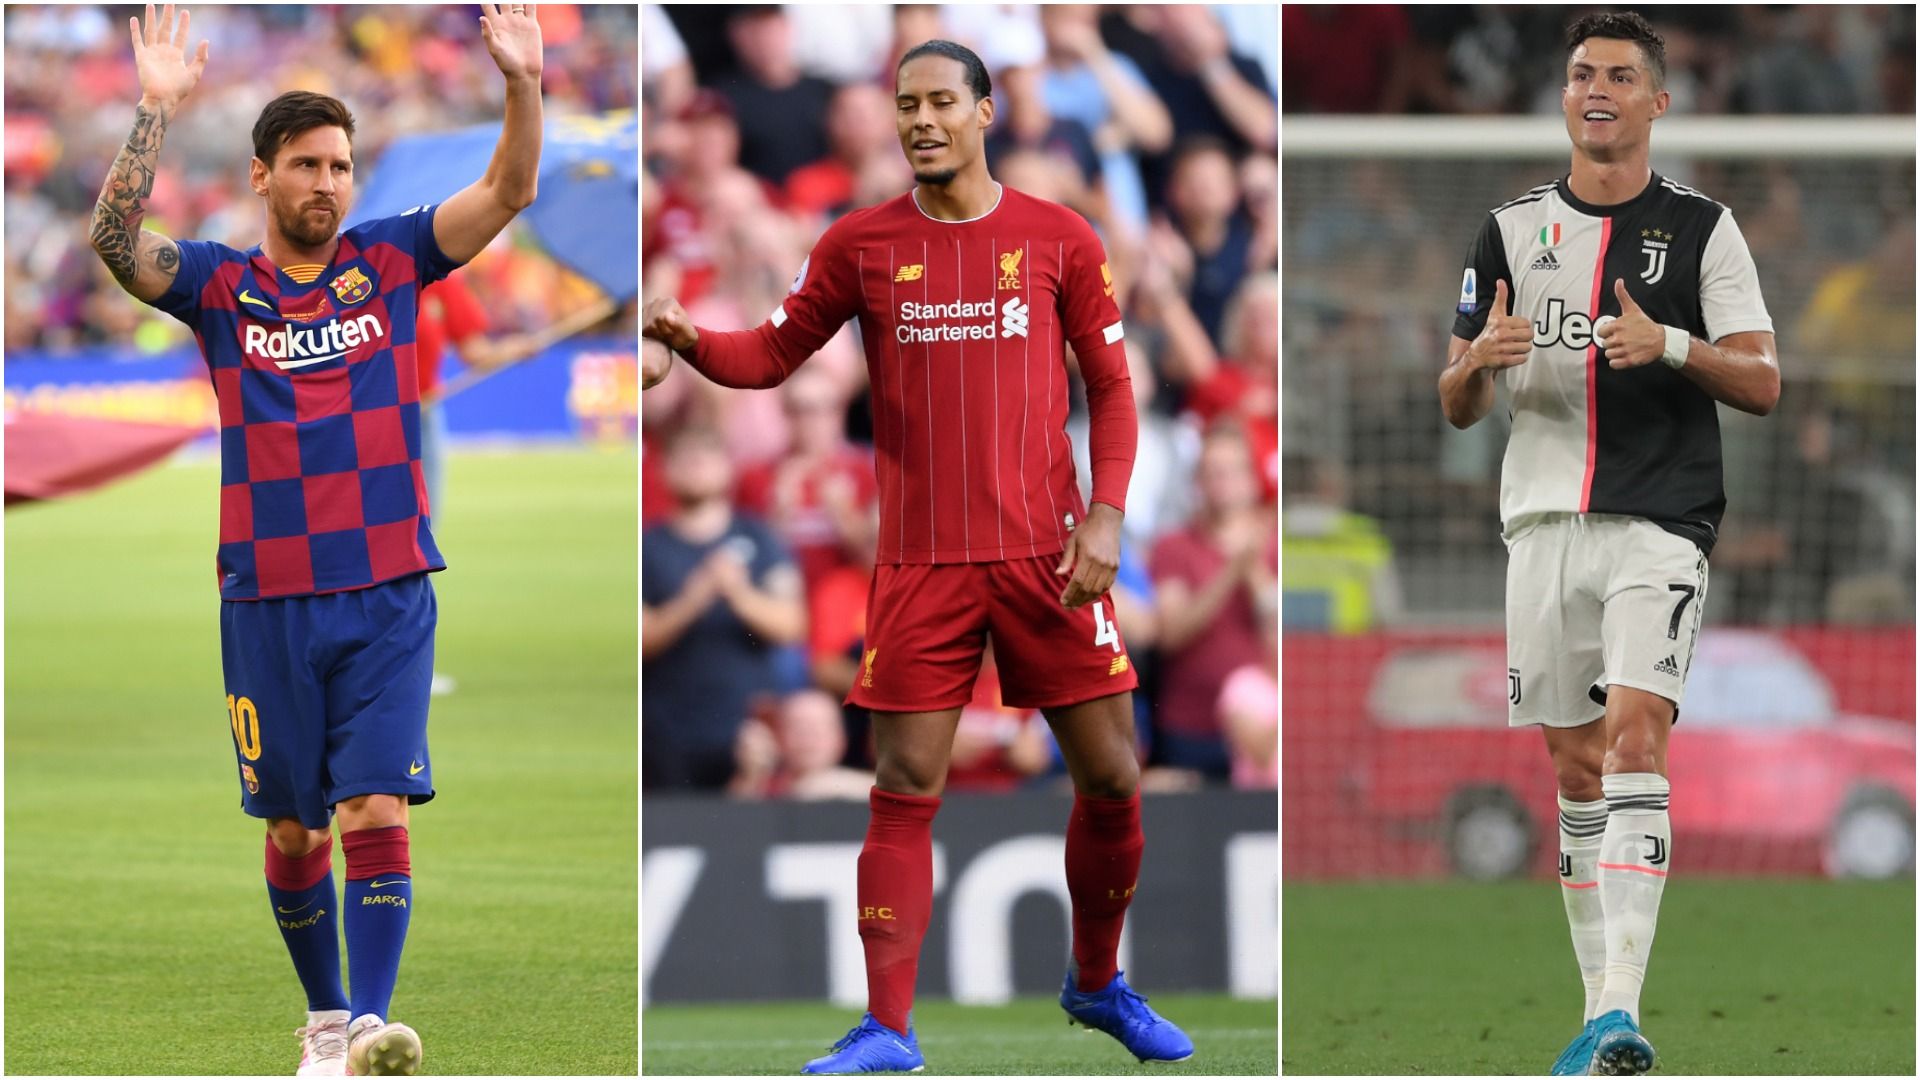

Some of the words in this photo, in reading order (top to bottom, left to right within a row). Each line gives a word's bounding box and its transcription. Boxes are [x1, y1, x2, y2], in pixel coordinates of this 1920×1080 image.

[900, 298, 996, 320] Standard
[245, 313, 384, 359] Rakuten
[896, 320, 996, 343] Chartered
[1092, 601, 1121, 653] 4
[1668, 583, 1695, 640] 7
[1654, 664, 1680, 677] adidas
[227, 694, 262, 761] 10
[362, 895, 407, 909] BARÇA
